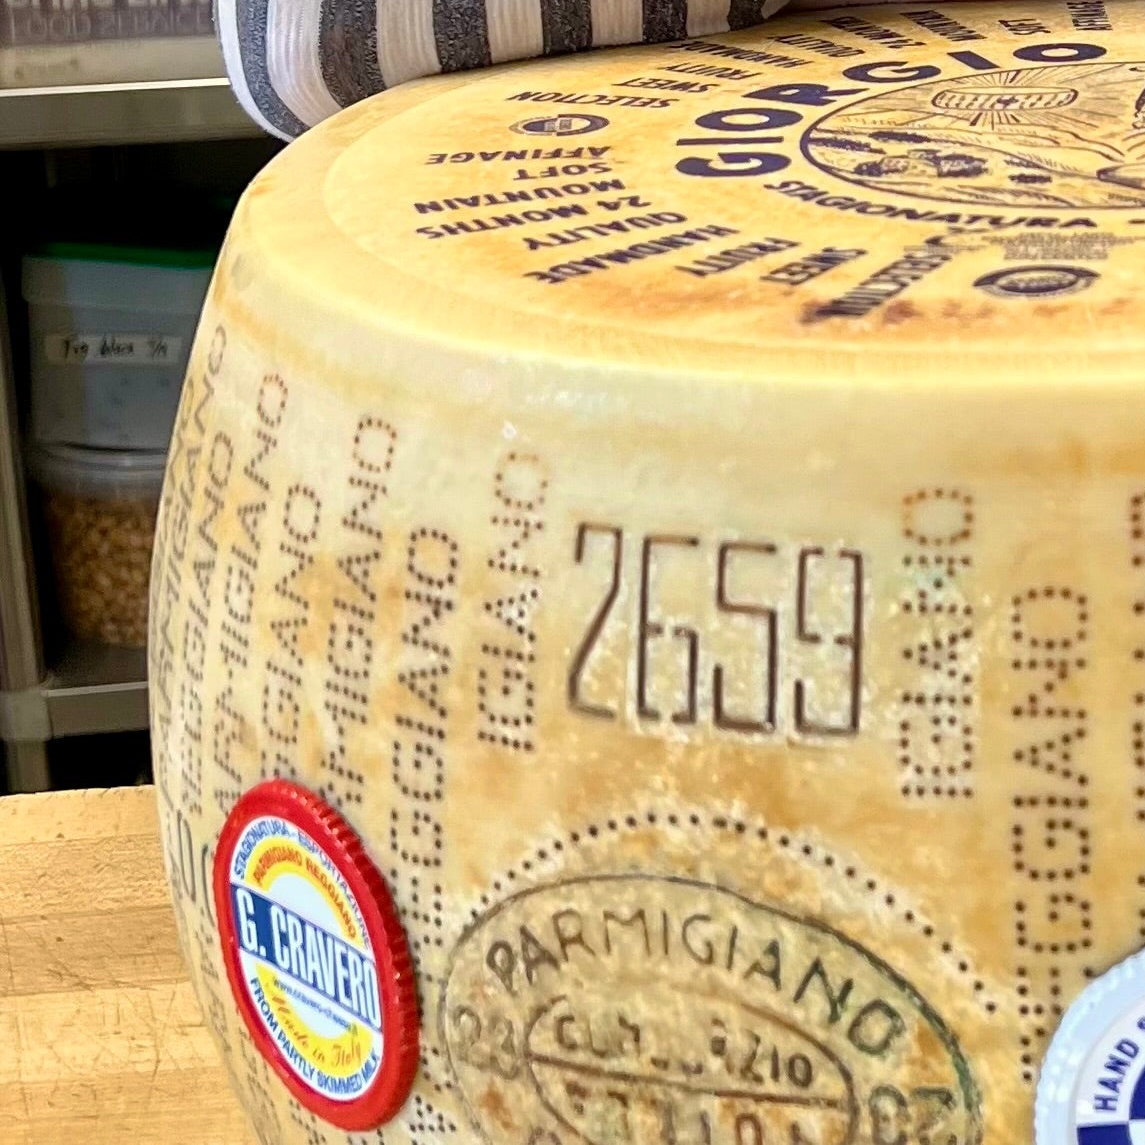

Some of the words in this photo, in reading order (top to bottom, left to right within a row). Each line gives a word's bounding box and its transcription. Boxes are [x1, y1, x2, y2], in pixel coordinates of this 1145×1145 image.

[505, 90, 682, 109] SELECTION
[611, 76, 720, 94] SWEET
[675, 43, 1108, 177] GIORGIO
[424, 145, 612, 166] AFFINAGE
[511, 161, 614, 182] SOFT
[413, 179, 627, 215] MOUNTAIN
[415, 202, 592, 240] MONTHS
[595, 195, 651, 212] 24
[763, 179, 1098, 229] STAGIONATURA
[521, 211, 690, 252] QUALITY
[522, 224, 742, 285] HANDMADE
[212, 371, 290, 819] ARMIGIANO
[567, 521, 864, 736] 2659
[235, 887, 267, 958] G.
[270, 904, 383, 1029] CRAVERO
[485, 907, 906, 1057] PARMIGIANO
[250, 976, 279, 1033] FROM
[277, 1028, 316, 1082] PARTLY
[315, 1070, 364, 1095] SKIMMED
[1094, 1039, 1141, 1113] HAND
